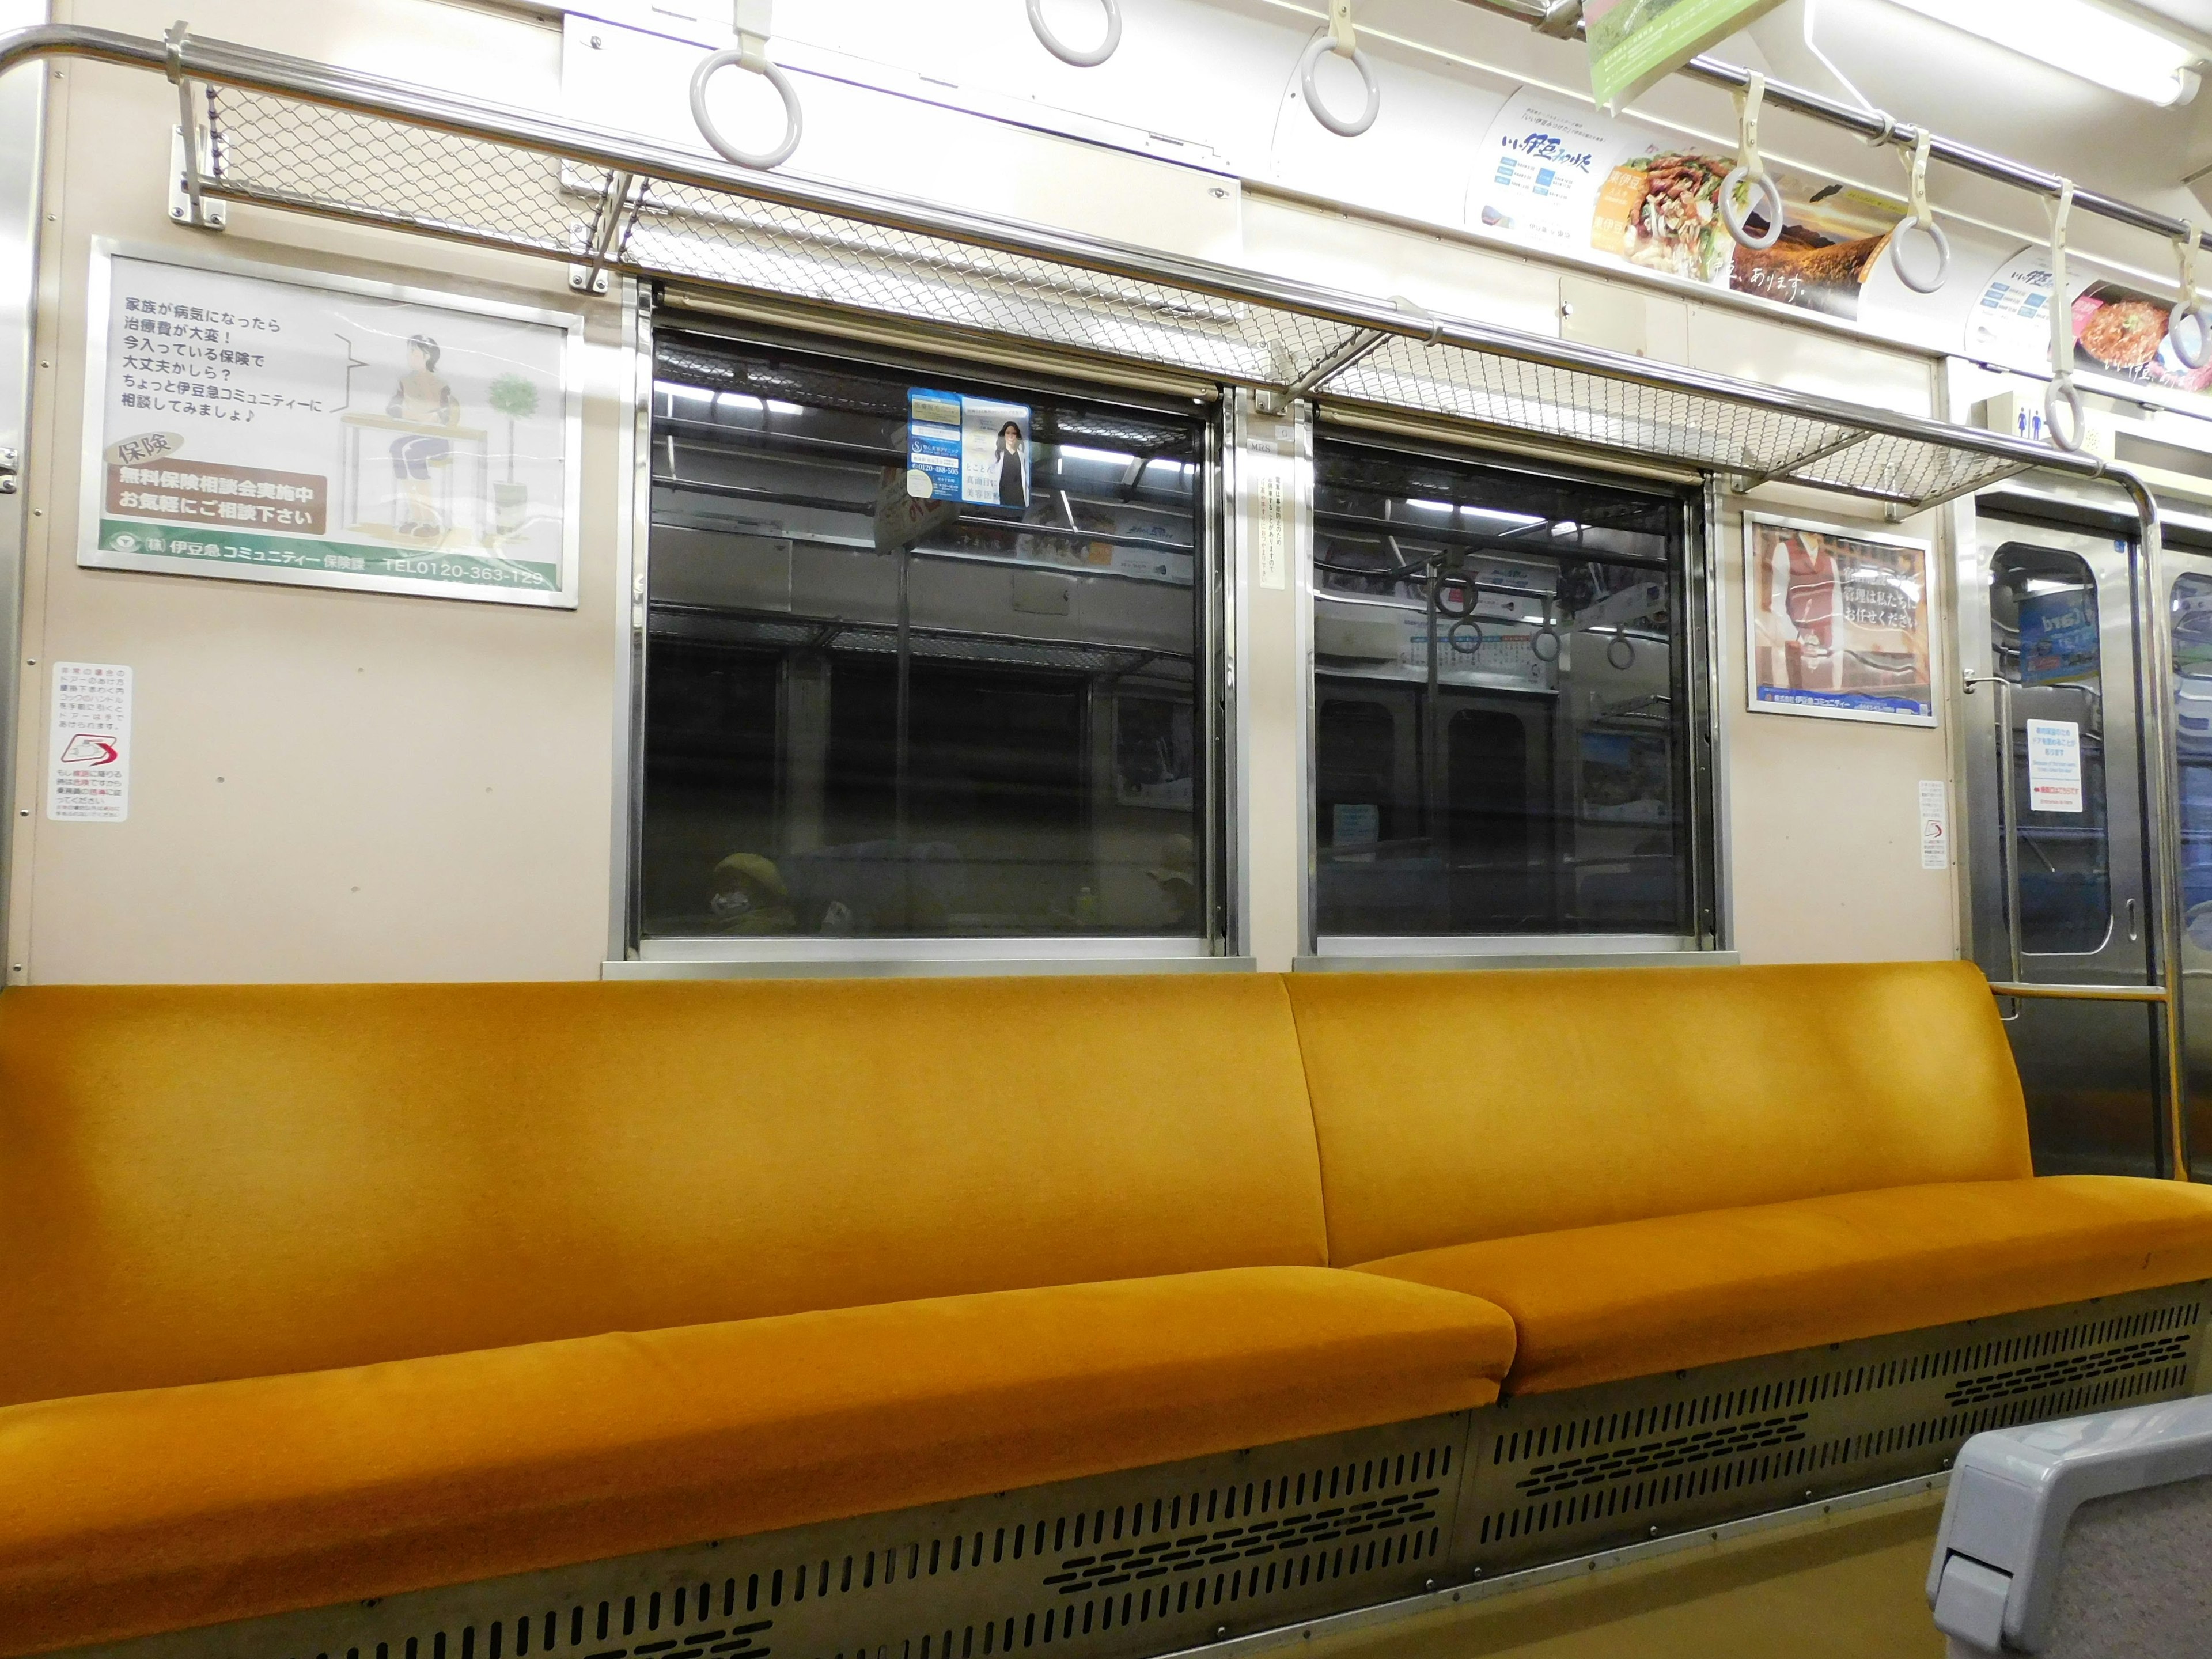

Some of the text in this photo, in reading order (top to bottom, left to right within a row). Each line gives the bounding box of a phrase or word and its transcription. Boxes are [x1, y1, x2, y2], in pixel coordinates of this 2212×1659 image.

[1608, 172, 1642, 191] 東伊豆
[126, 297, 281, 332] 家族が病気になったら
[124, 316, 230, 343] 治療費が大変！
[124, 335, 264, 367] 今入っている保険で
[123, 355, 230, 381] 大丈夫かしら？
[123, 374, 323, 412] ちょっと伊豆急コミュニティーに
[118, 434, 171, 464] 保険
[1251, 443, 1271, 453] MRS
[918, 464, 959, 475] 0120-488-505
[967, 463, 995, 474] とことん
[967, 476, 998, 487] 真面目に
[119, 467, 313, 503] 無料保険相談会実施中
[119, 491, 312, 525] お気軽にご相談下さい
[1843, 586, 1917, 609] 管理は私たちに
[1844, 607, 1918, 628] お任せください
